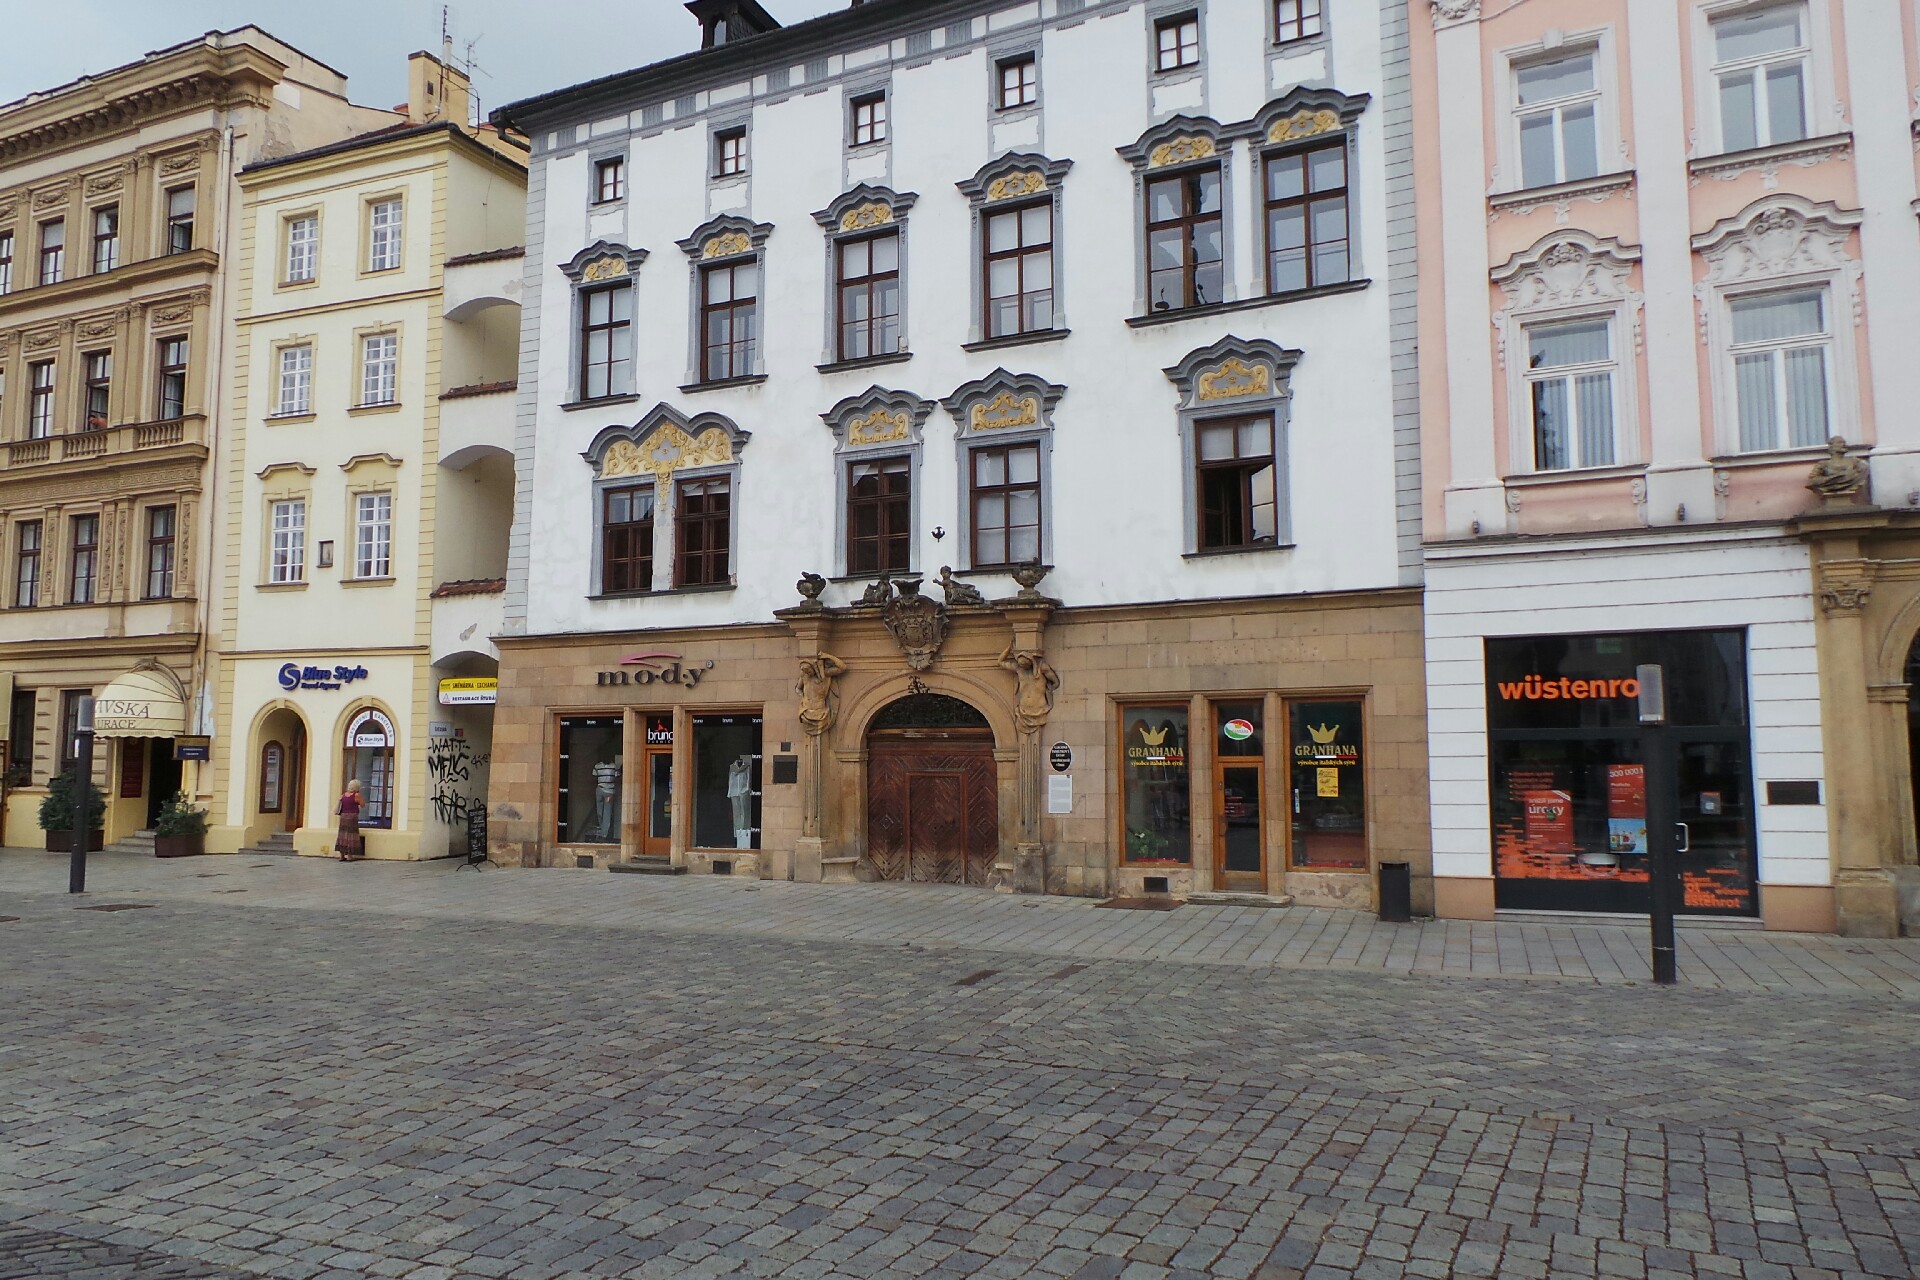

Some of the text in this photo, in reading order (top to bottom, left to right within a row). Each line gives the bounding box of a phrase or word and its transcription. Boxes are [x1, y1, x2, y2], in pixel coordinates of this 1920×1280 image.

[301, 664, 368, 684] Blue Style
[1498, 674, 1641, 700] wüstenro
[1128, 747, 1184, 758] GRANHANA
[1294, 745, 1357, 756] GRANHANA
